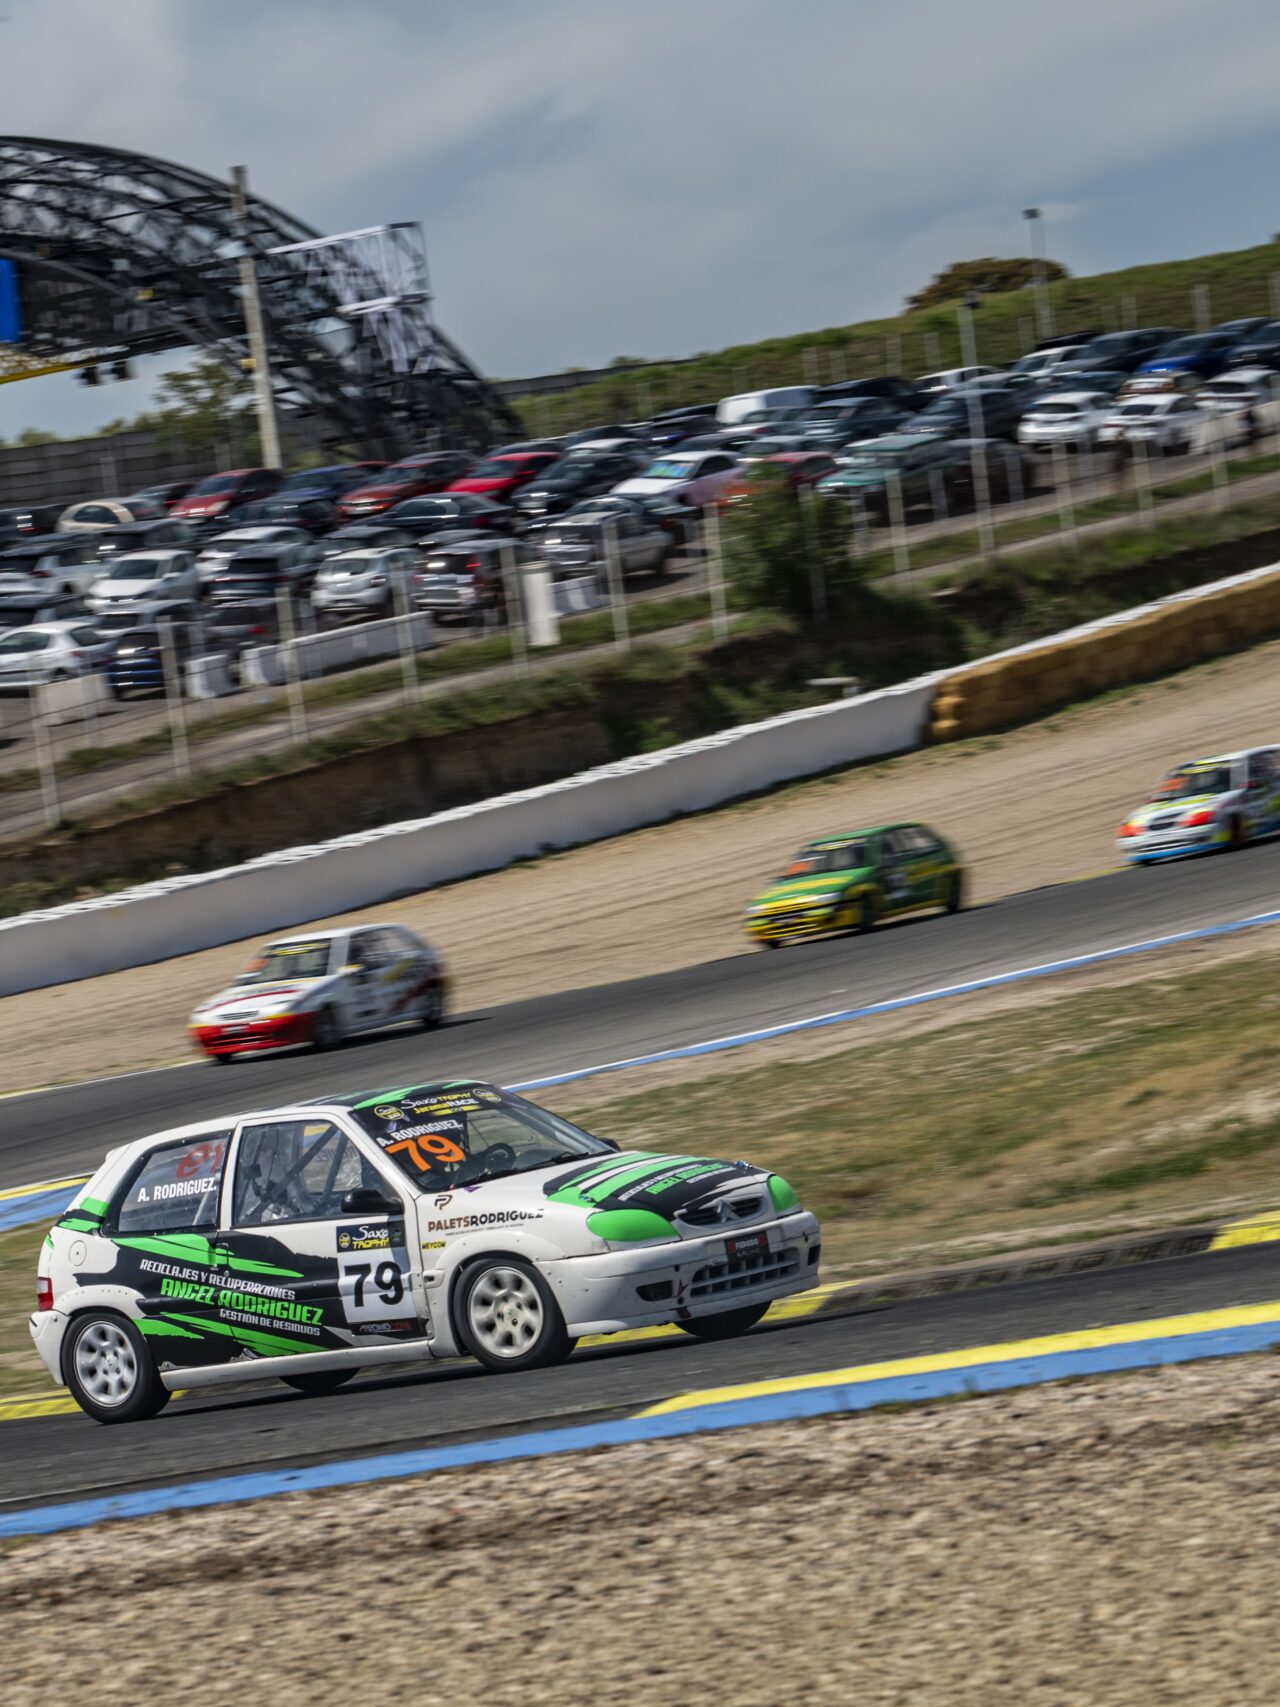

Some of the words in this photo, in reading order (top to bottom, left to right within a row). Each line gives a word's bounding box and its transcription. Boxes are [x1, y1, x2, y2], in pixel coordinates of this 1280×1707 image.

[401, 1097, 437, 1110] Saxo
[391, 1119, 464, 1141] RODRIGUEZ
[384, 1134, 465, 1172] 79
[137, 1187, 150, 1203] A.
[352, 1225, 389, 1240] Saxo
[352, 1238, 389, 1250] TROPHY
[140, 1258, 199, 1282] RECICLAJES
[200, 1271, 209, 1283] Y
[344, 1260, 404, 1308] 79
[160, 1278, 215, 1305] ANGEL
[218, 1290, 324, 1326] RODRIGUEZ
[259, 1317, 272, 1327] DE
[273, 1319, 321, 1336] RESIDUOS
